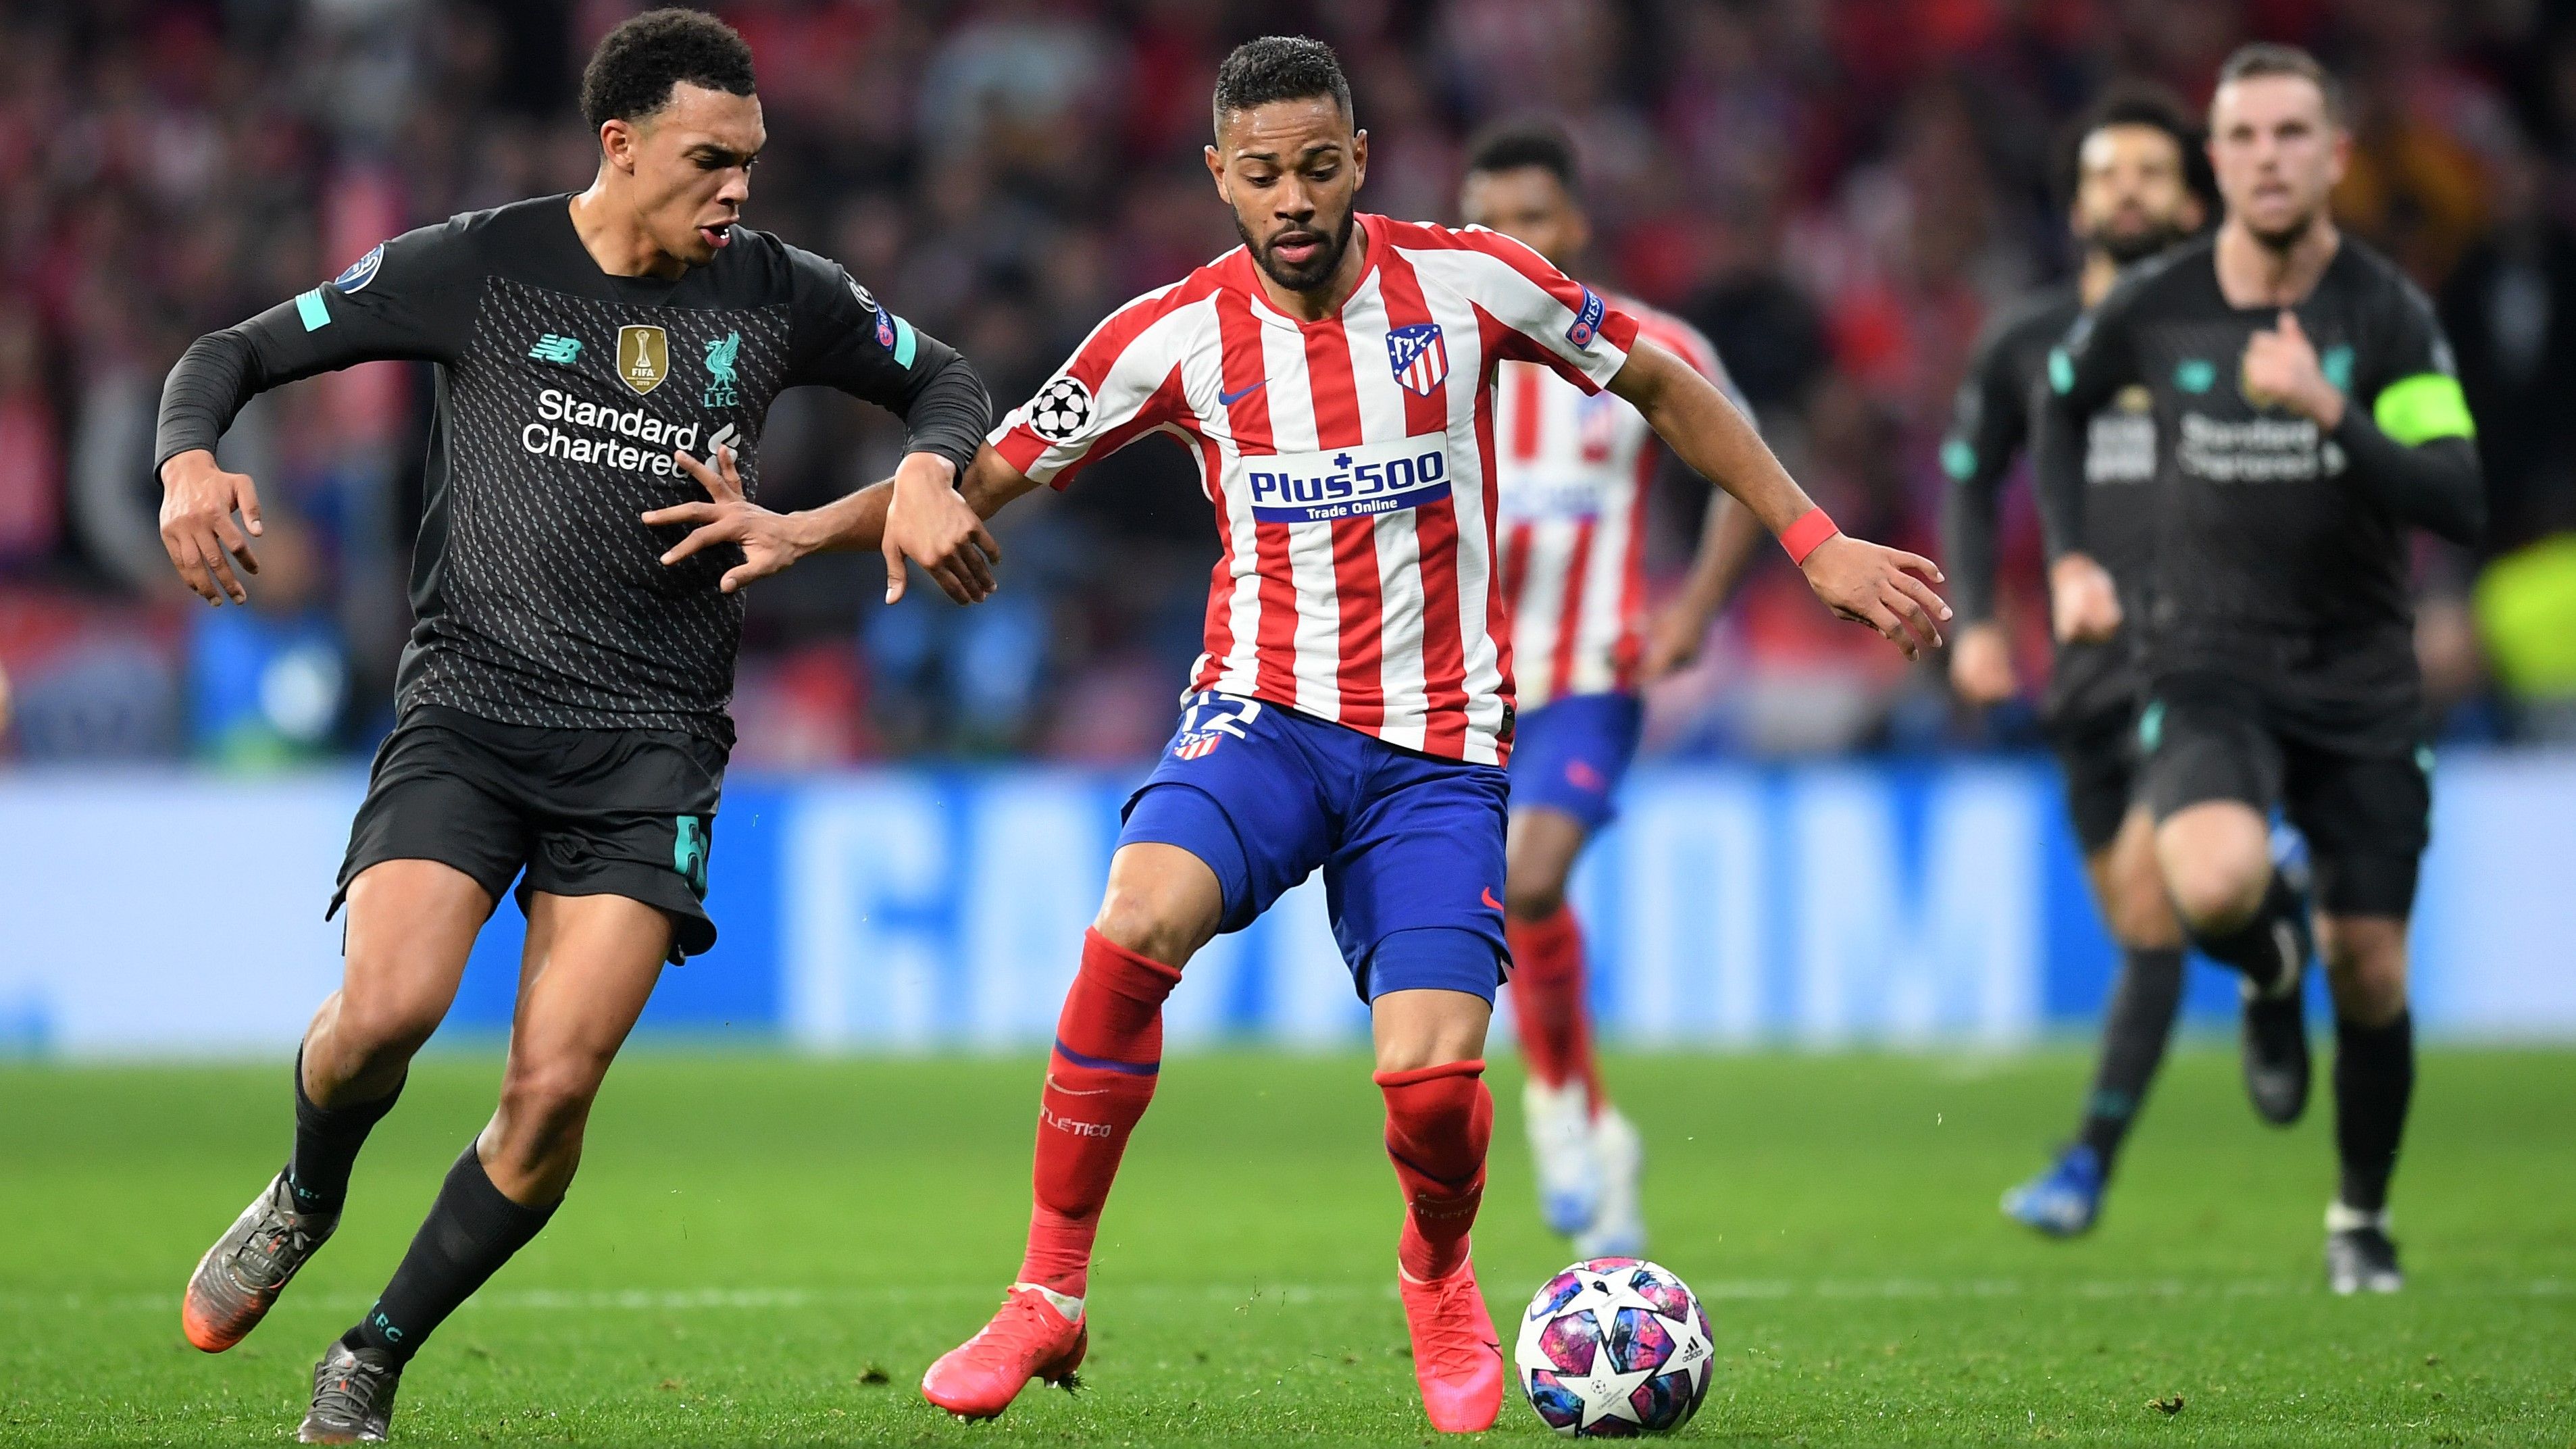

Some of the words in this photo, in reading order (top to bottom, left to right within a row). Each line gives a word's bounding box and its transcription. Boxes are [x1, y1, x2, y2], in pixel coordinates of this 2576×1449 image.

[632, 367, 655, 377] FIFA
[704, 391, 739, 407] LFC
[538, 390, 698, 451] Standard
[1250, 451, 1444, 502] Plus500
[1307, 506, 1347, 519] Trade
[1352, 499, 1398, 514] Online
[1182, 691, 1261, 739] 12
